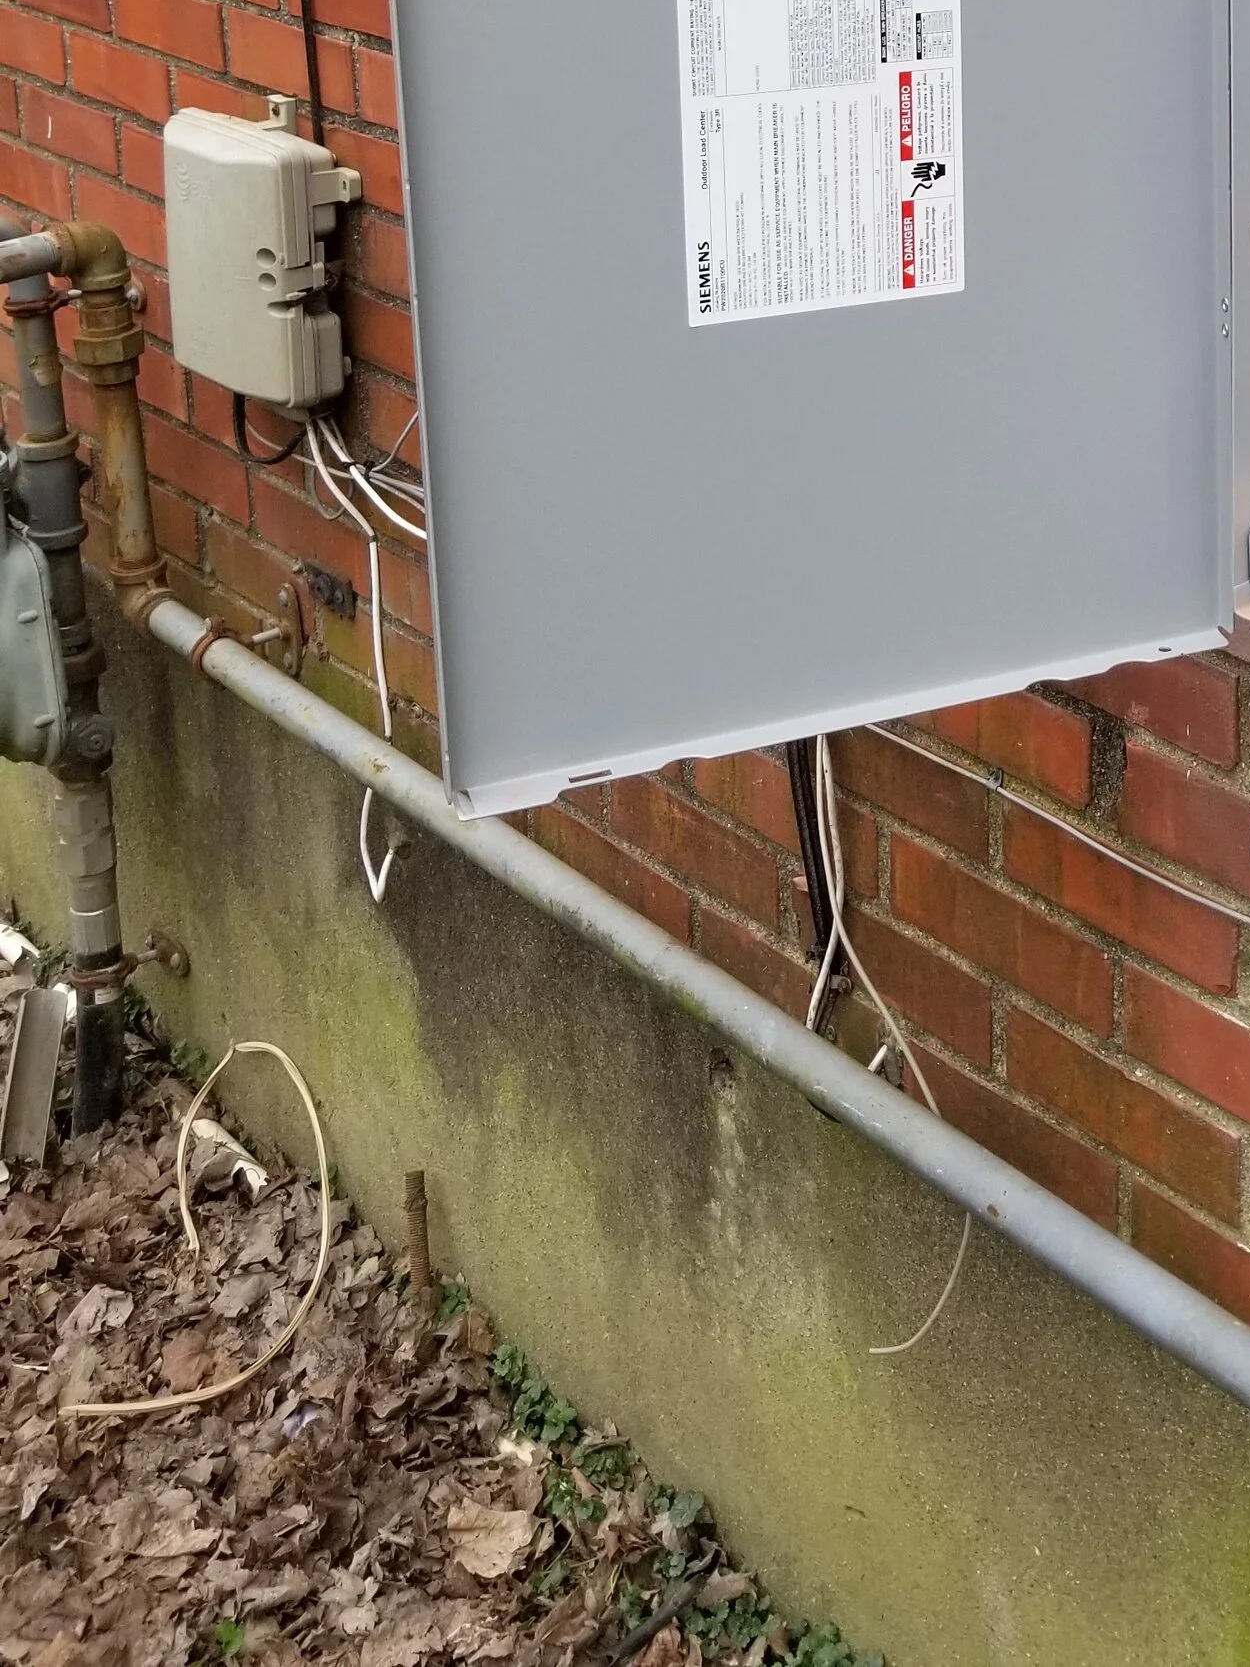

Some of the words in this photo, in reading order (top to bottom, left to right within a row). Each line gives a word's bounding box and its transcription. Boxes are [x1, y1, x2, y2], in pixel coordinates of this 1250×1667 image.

[714, 108, 721, 117] 3R
[901, 84, 911, 133] PELIGRO
[699, 110, 707, 136] Center
[714, 119, 722, 133] Type
[699, 137, 707, 158] Load
[700, 159, 709, 190] Outdoor
[774, 212, 782, 239] SERVICE
[903, 216, 914, 261] DANGER
[696, 241, 712, 314] SIEMENS
